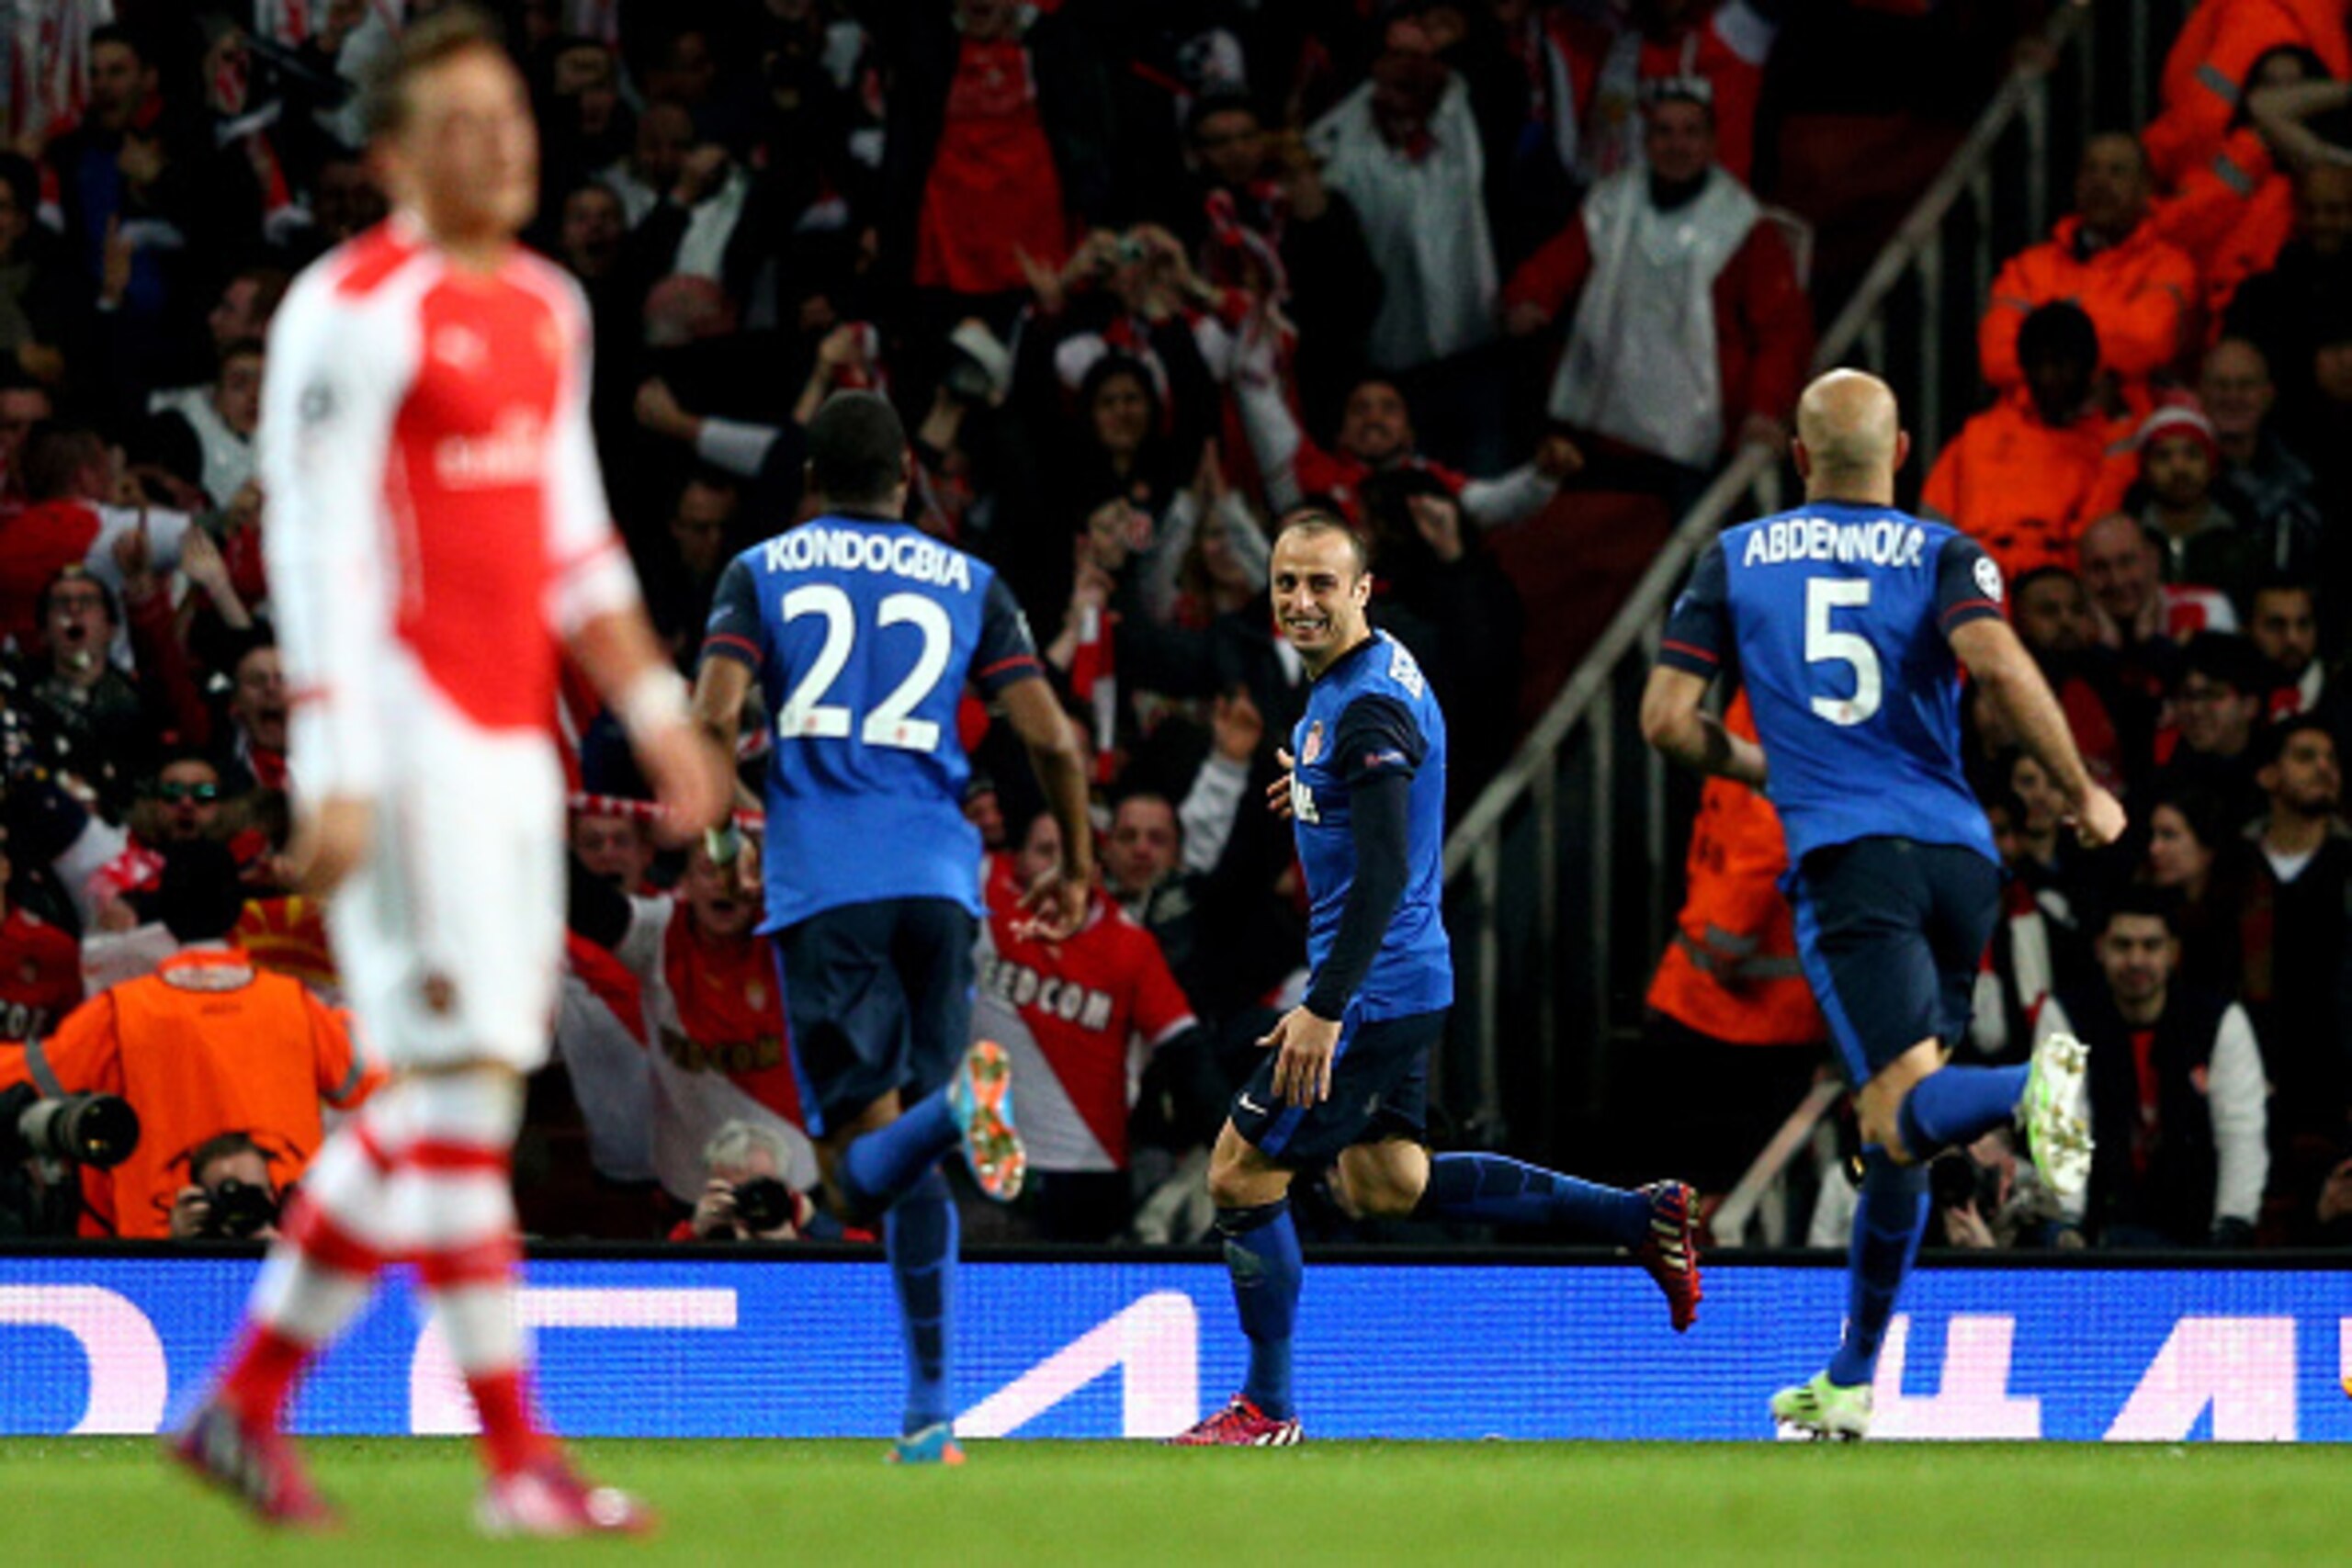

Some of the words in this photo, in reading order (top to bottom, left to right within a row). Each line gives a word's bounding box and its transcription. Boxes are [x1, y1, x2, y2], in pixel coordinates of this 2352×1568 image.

[766, 529, 970, 592] KONDOGBIA
[777, 583, 953, 752] 22
[1805, 577, 1883, 726] 5
